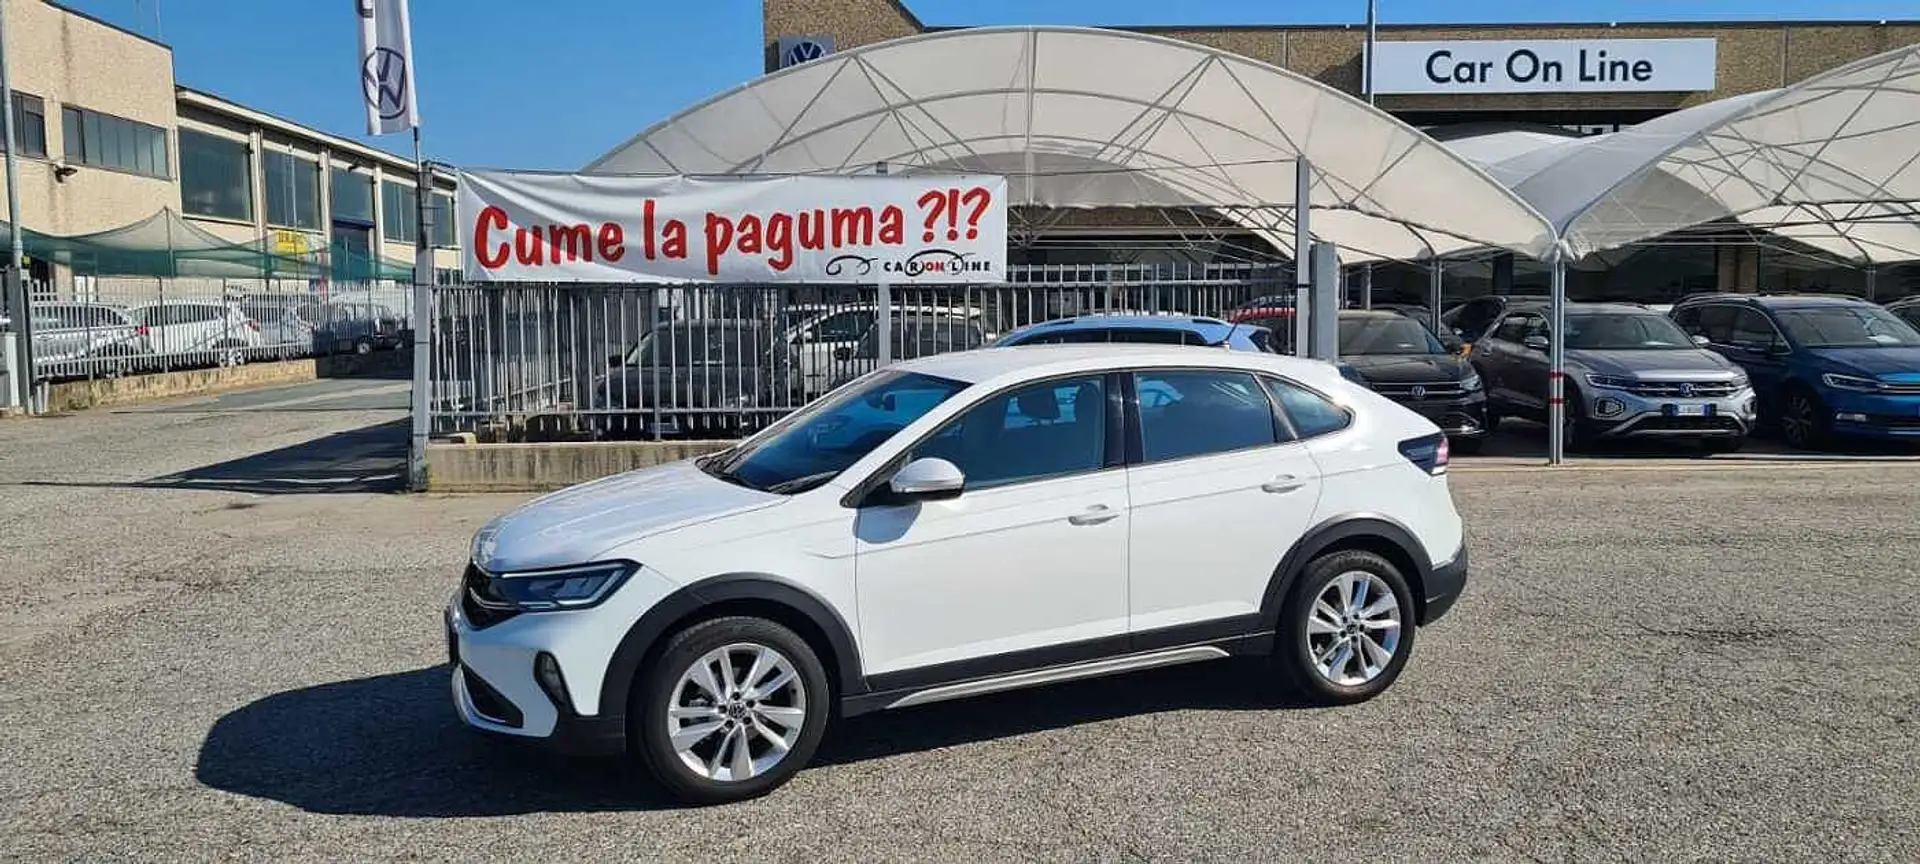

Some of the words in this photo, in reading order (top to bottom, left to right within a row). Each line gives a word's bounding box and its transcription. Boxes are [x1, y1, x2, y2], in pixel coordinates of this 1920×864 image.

[1425, 50, 1493, 84] Car
[1506, 49, 1562, 83] On
[1579, 49, 1653, 82] Line
[474, 205, 625, 269] Cume
[643, 199, 687, 260] la
[704, 205, 904, 275] paguma
[917, 187, 991, 242] ?!?
